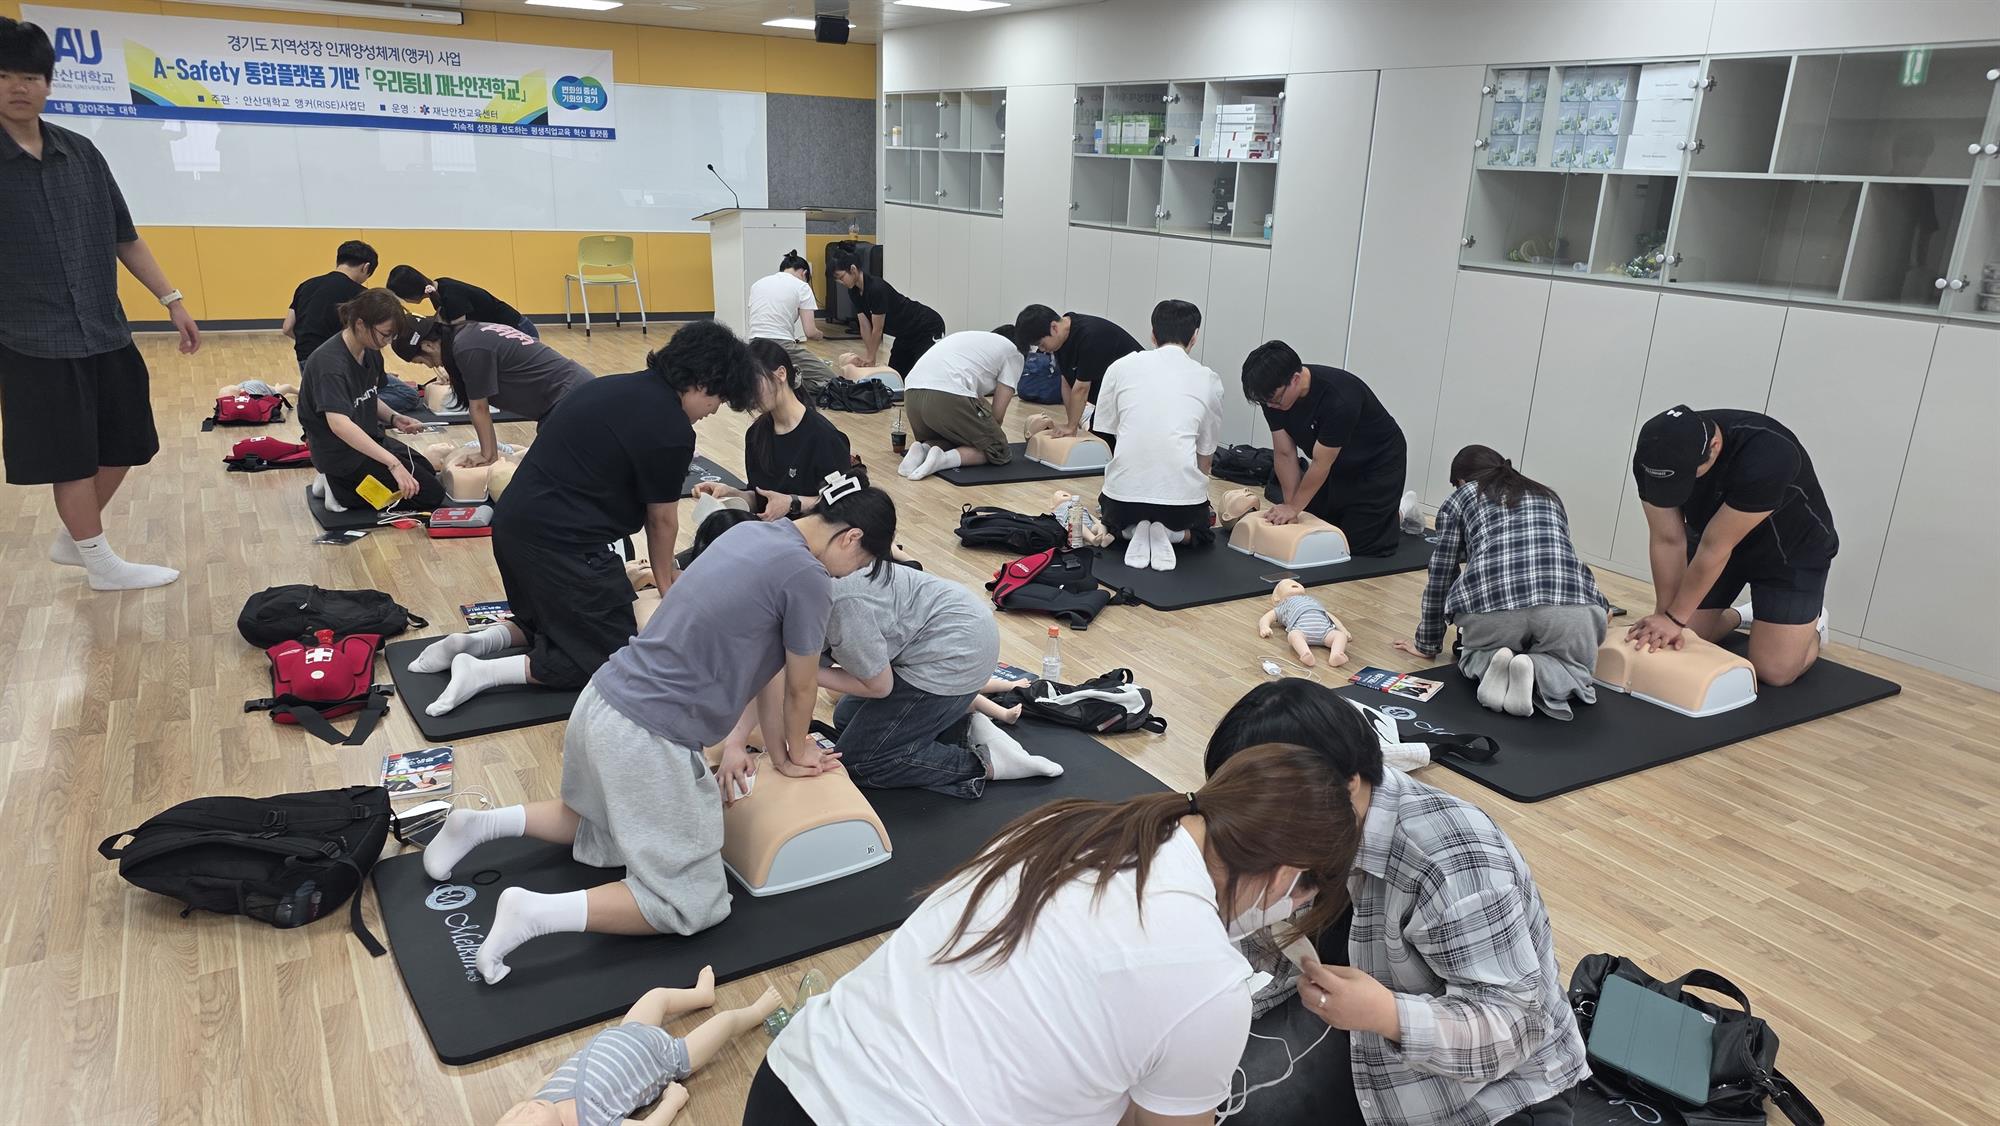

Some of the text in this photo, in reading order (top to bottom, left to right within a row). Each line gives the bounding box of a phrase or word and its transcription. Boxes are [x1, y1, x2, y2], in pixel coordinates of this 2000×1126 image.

[54, 27, 103, 65] AU
[227, 35, 461, 67] 경기도 지역성장 인재양성체계(앵커) 사업
[153, 57, 526, 102] A-Safety 통합플랫폼 기반 「우리동네 재난안전학교」
[75, 83, 116, 92] UNIVERSITY
[561, 86, 598, 96] 변화의 중심
[211, 94, 230, 105] 주관
[243, 95, 290, 107] 안산대학교
[295, 98, 366, 111] 앵커(RISE)사업단
[561, 95, 598, 104] 기회의 경기
[54, 103, 137, 116] 나를 알아주는 대학
[392, 103, 409, 114] 운영
[433, 106, 498, 119] 재난안전교육센터
[453, 123, 609, 138] 지속적 성장을 선도하는 평생직업교육 혁신 플랫폼
